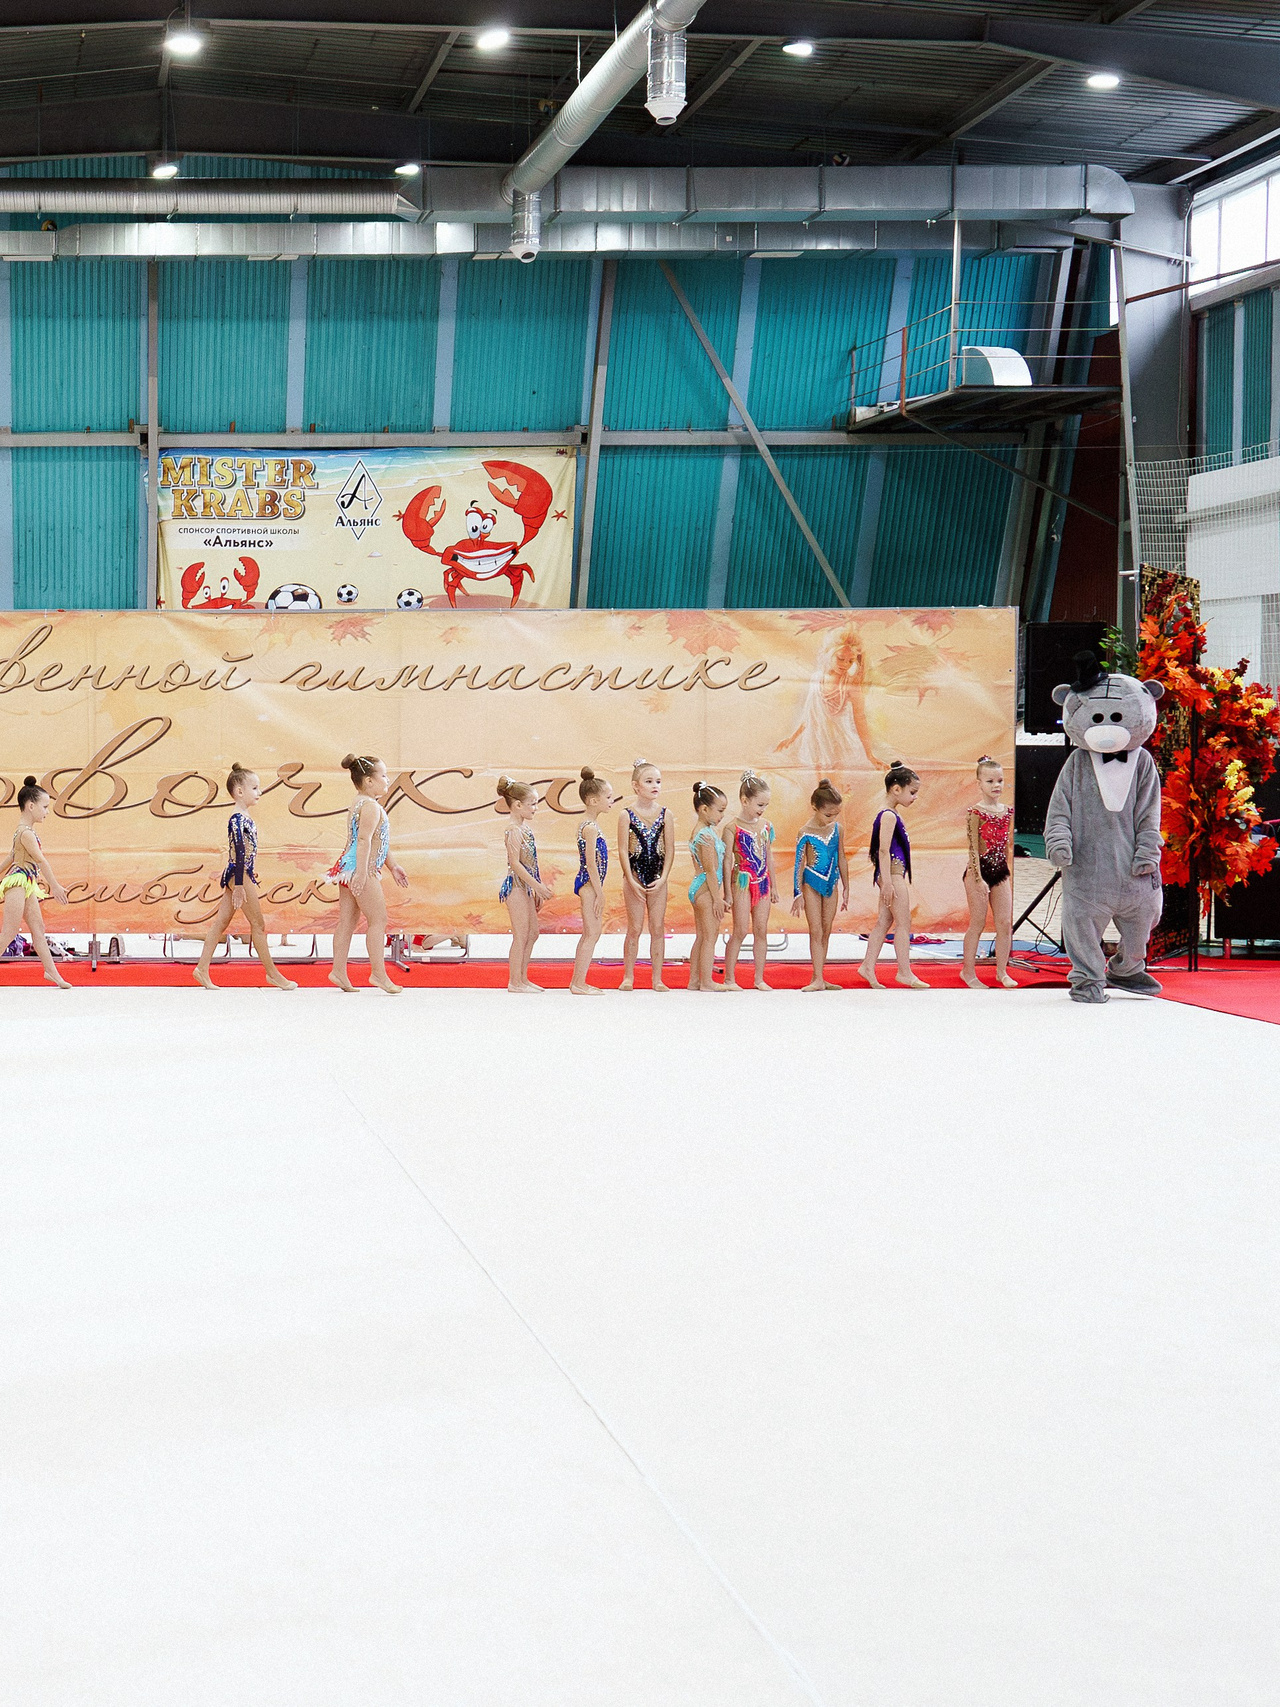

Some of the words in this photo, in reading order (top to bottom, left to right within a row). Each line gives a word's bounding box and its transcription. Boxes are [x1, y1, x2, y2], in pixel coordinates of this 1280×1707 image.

[160, 457, 318, 489] MISTER
[171, 488, 306, 520] KRABS
[178, 527, 215, 535] СПОНСОР
[216, 526, 268, 535] СПОРТИВНОЙ
[270, 528, 300, 536] ШКОЛЫ
[335, 515, 381, 527] Альянс
[203, 535, 274, 548] «Альянс»
[280, 653, 782, 692] гимнастике
